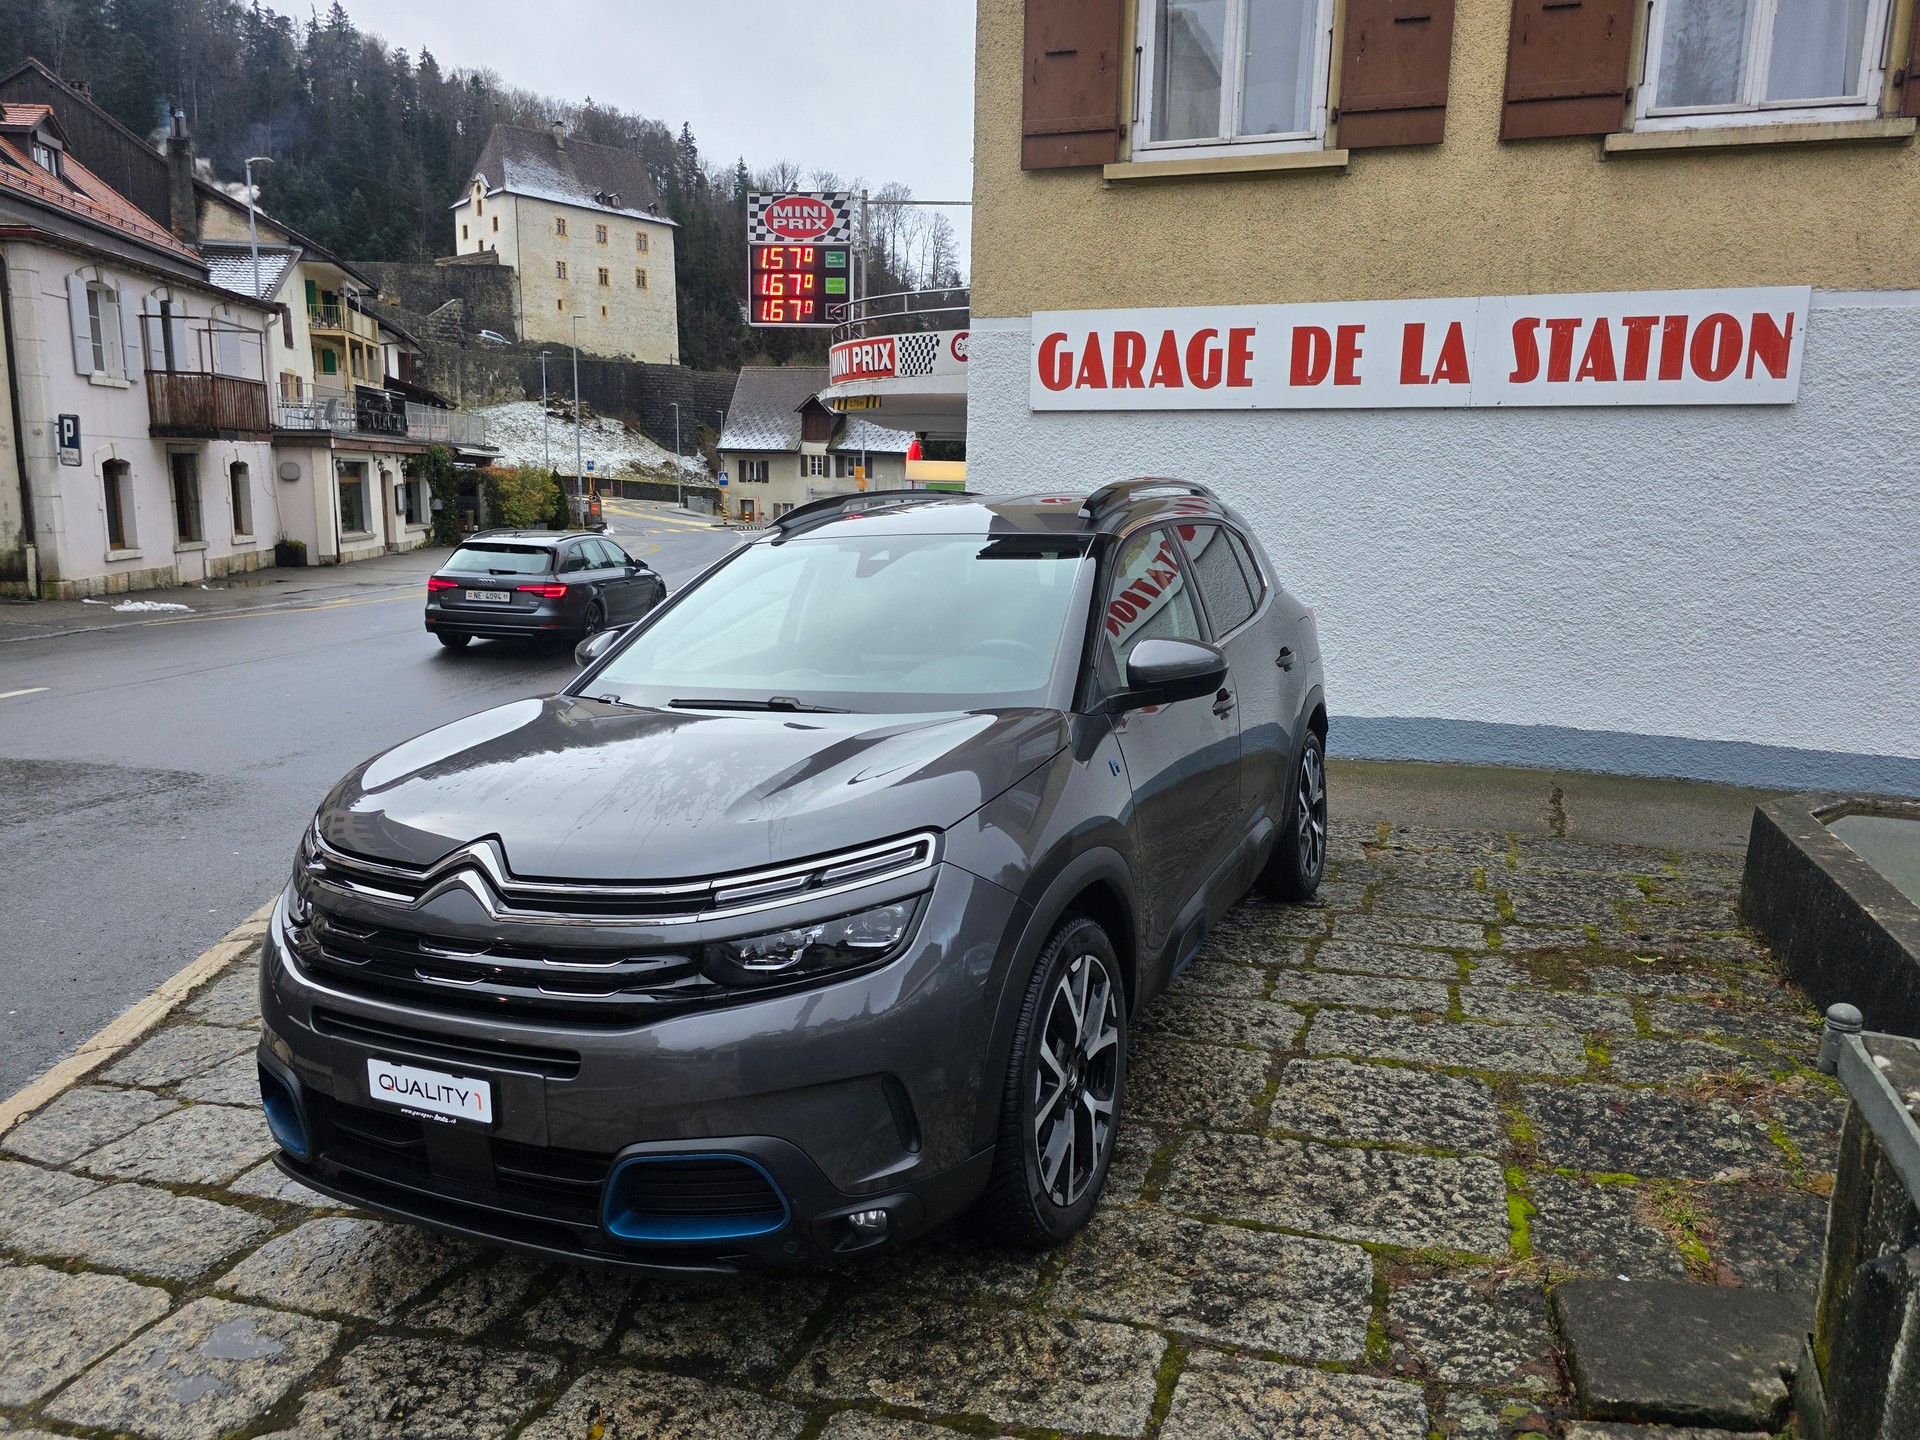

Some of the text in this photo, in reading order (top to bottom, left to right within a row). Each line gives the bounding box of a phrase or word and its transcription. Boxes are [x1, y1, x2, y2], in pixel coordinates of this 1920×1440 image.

[772, 206, 828, 218] MINI
[772, 219, 828, 230] PRIX
[831, 343, 893, 377] MINI PRIX
[1038, 312, 1795, 392] GARAGE DE LA STATION
[63, 418, 74, 446] P
